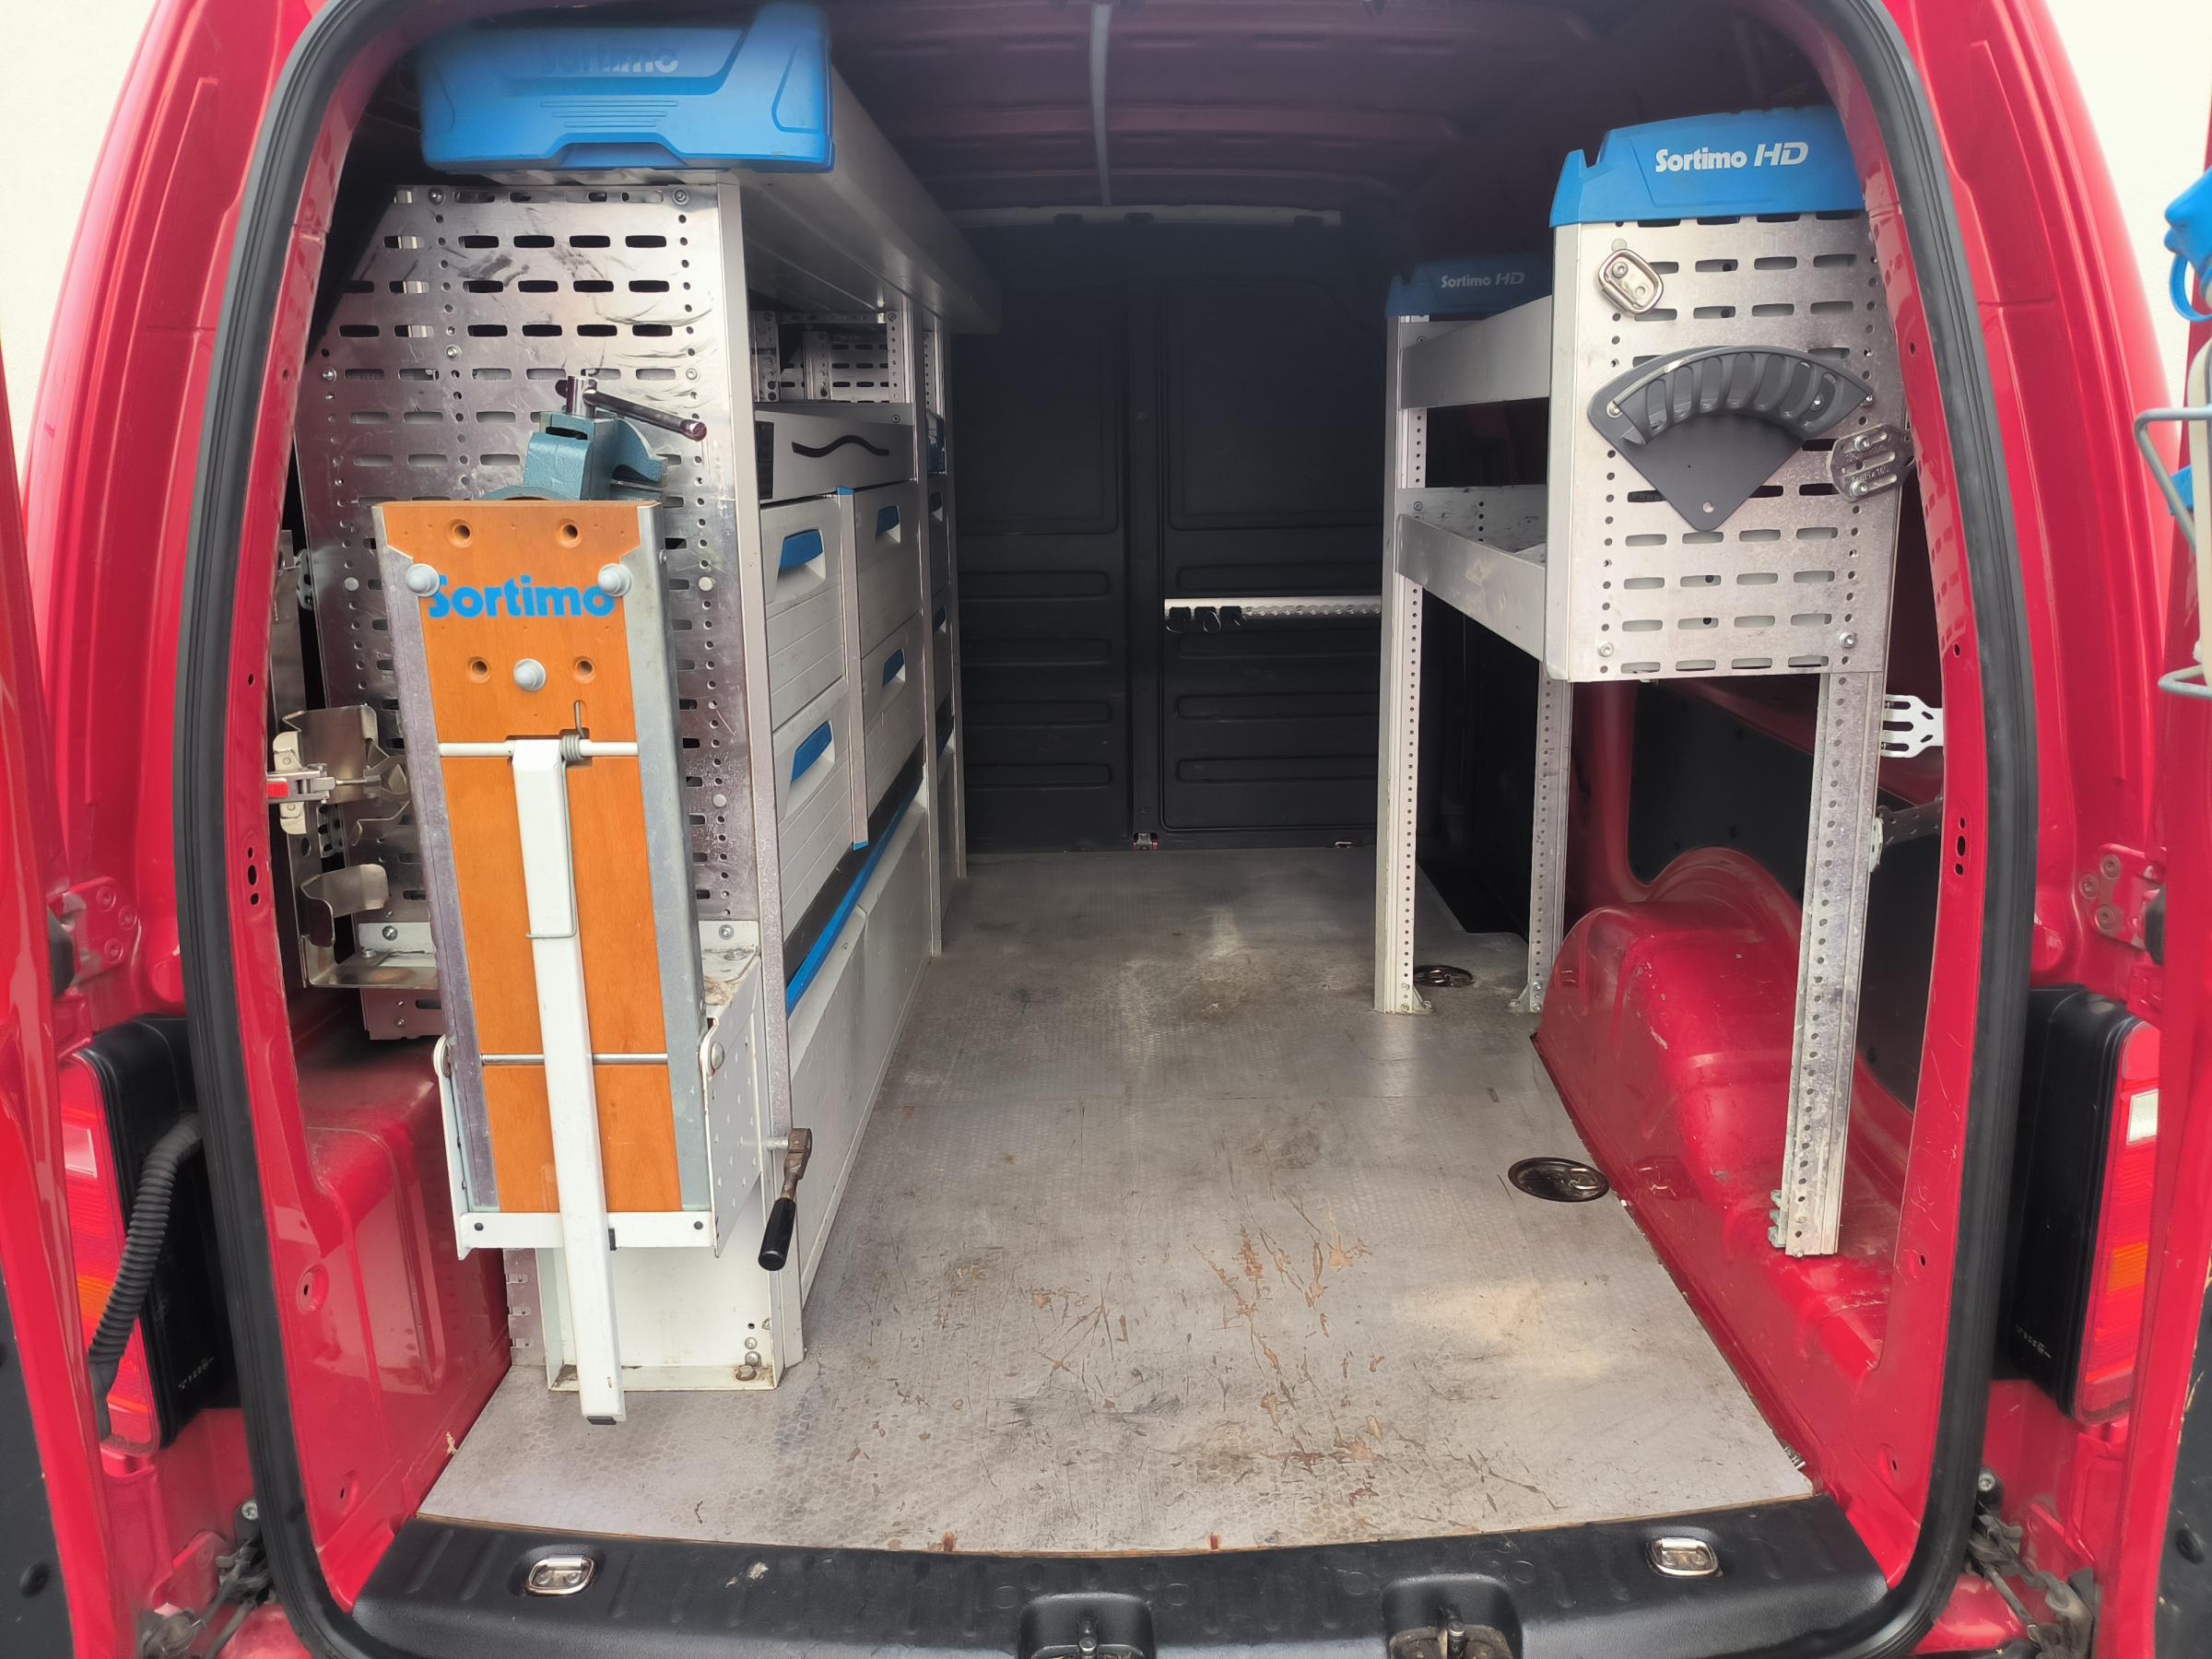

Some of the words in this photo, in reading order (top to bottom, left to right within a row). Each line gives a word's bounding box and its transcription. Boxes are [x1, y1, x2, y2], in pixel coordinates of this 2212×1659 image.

[1654, 147, 1748, 173] Sortimo
[1753, 141, 1809, 167] HD
[1441, 275, 1491, 288] Sortimo
[1495, 272, 1525, 286] HD
[428, 574, 616, 619] Sortimo
